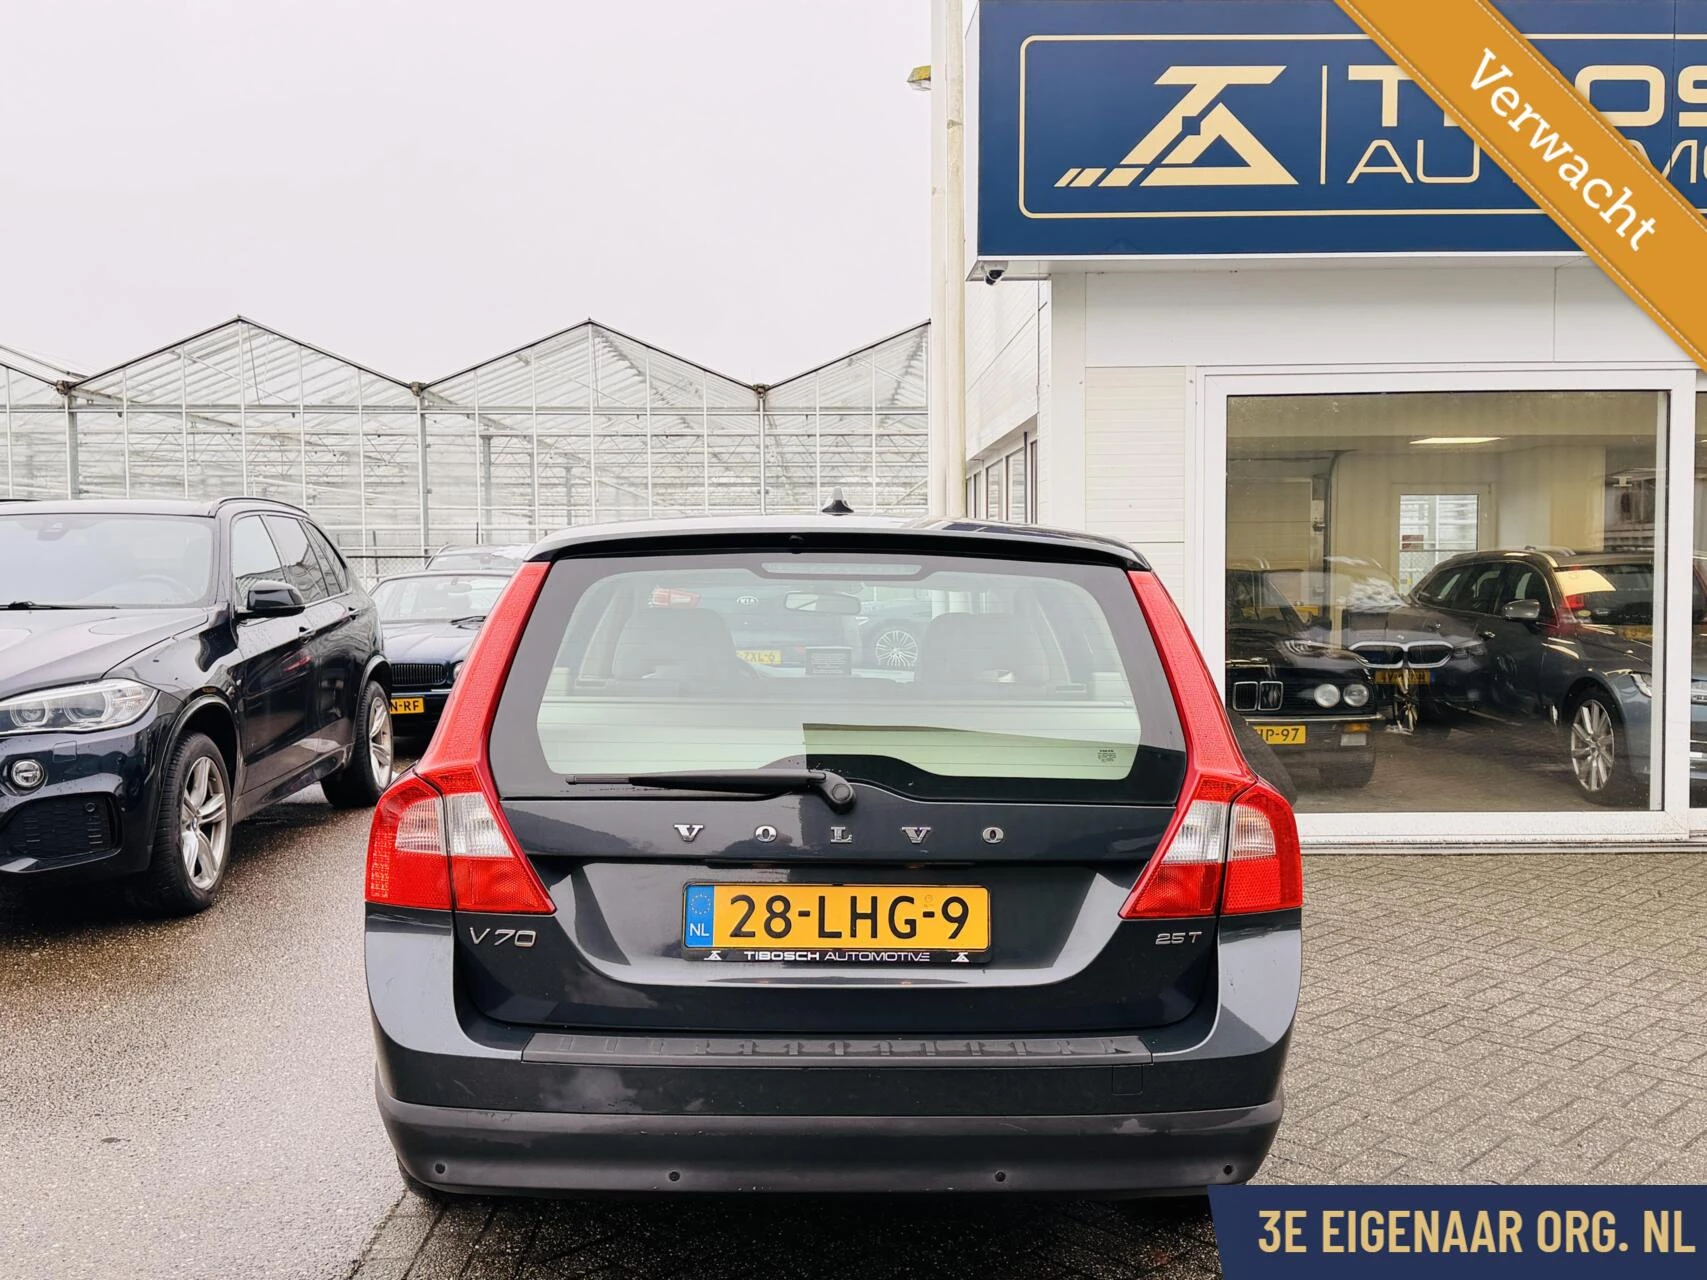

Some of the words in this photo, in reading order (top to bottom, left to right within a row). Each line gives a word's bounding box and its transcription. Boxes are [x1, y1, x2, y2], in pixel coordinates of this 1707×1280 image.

[674, 823, 1004, 844] VOLVO
[729, 894, 970, 940] 28-LHG-9
[689, 922, 710, 937] NL
[744, 951, 820, 961] TIBOSCH
[824, 951, 930, 962] AUTOMOTIVE
